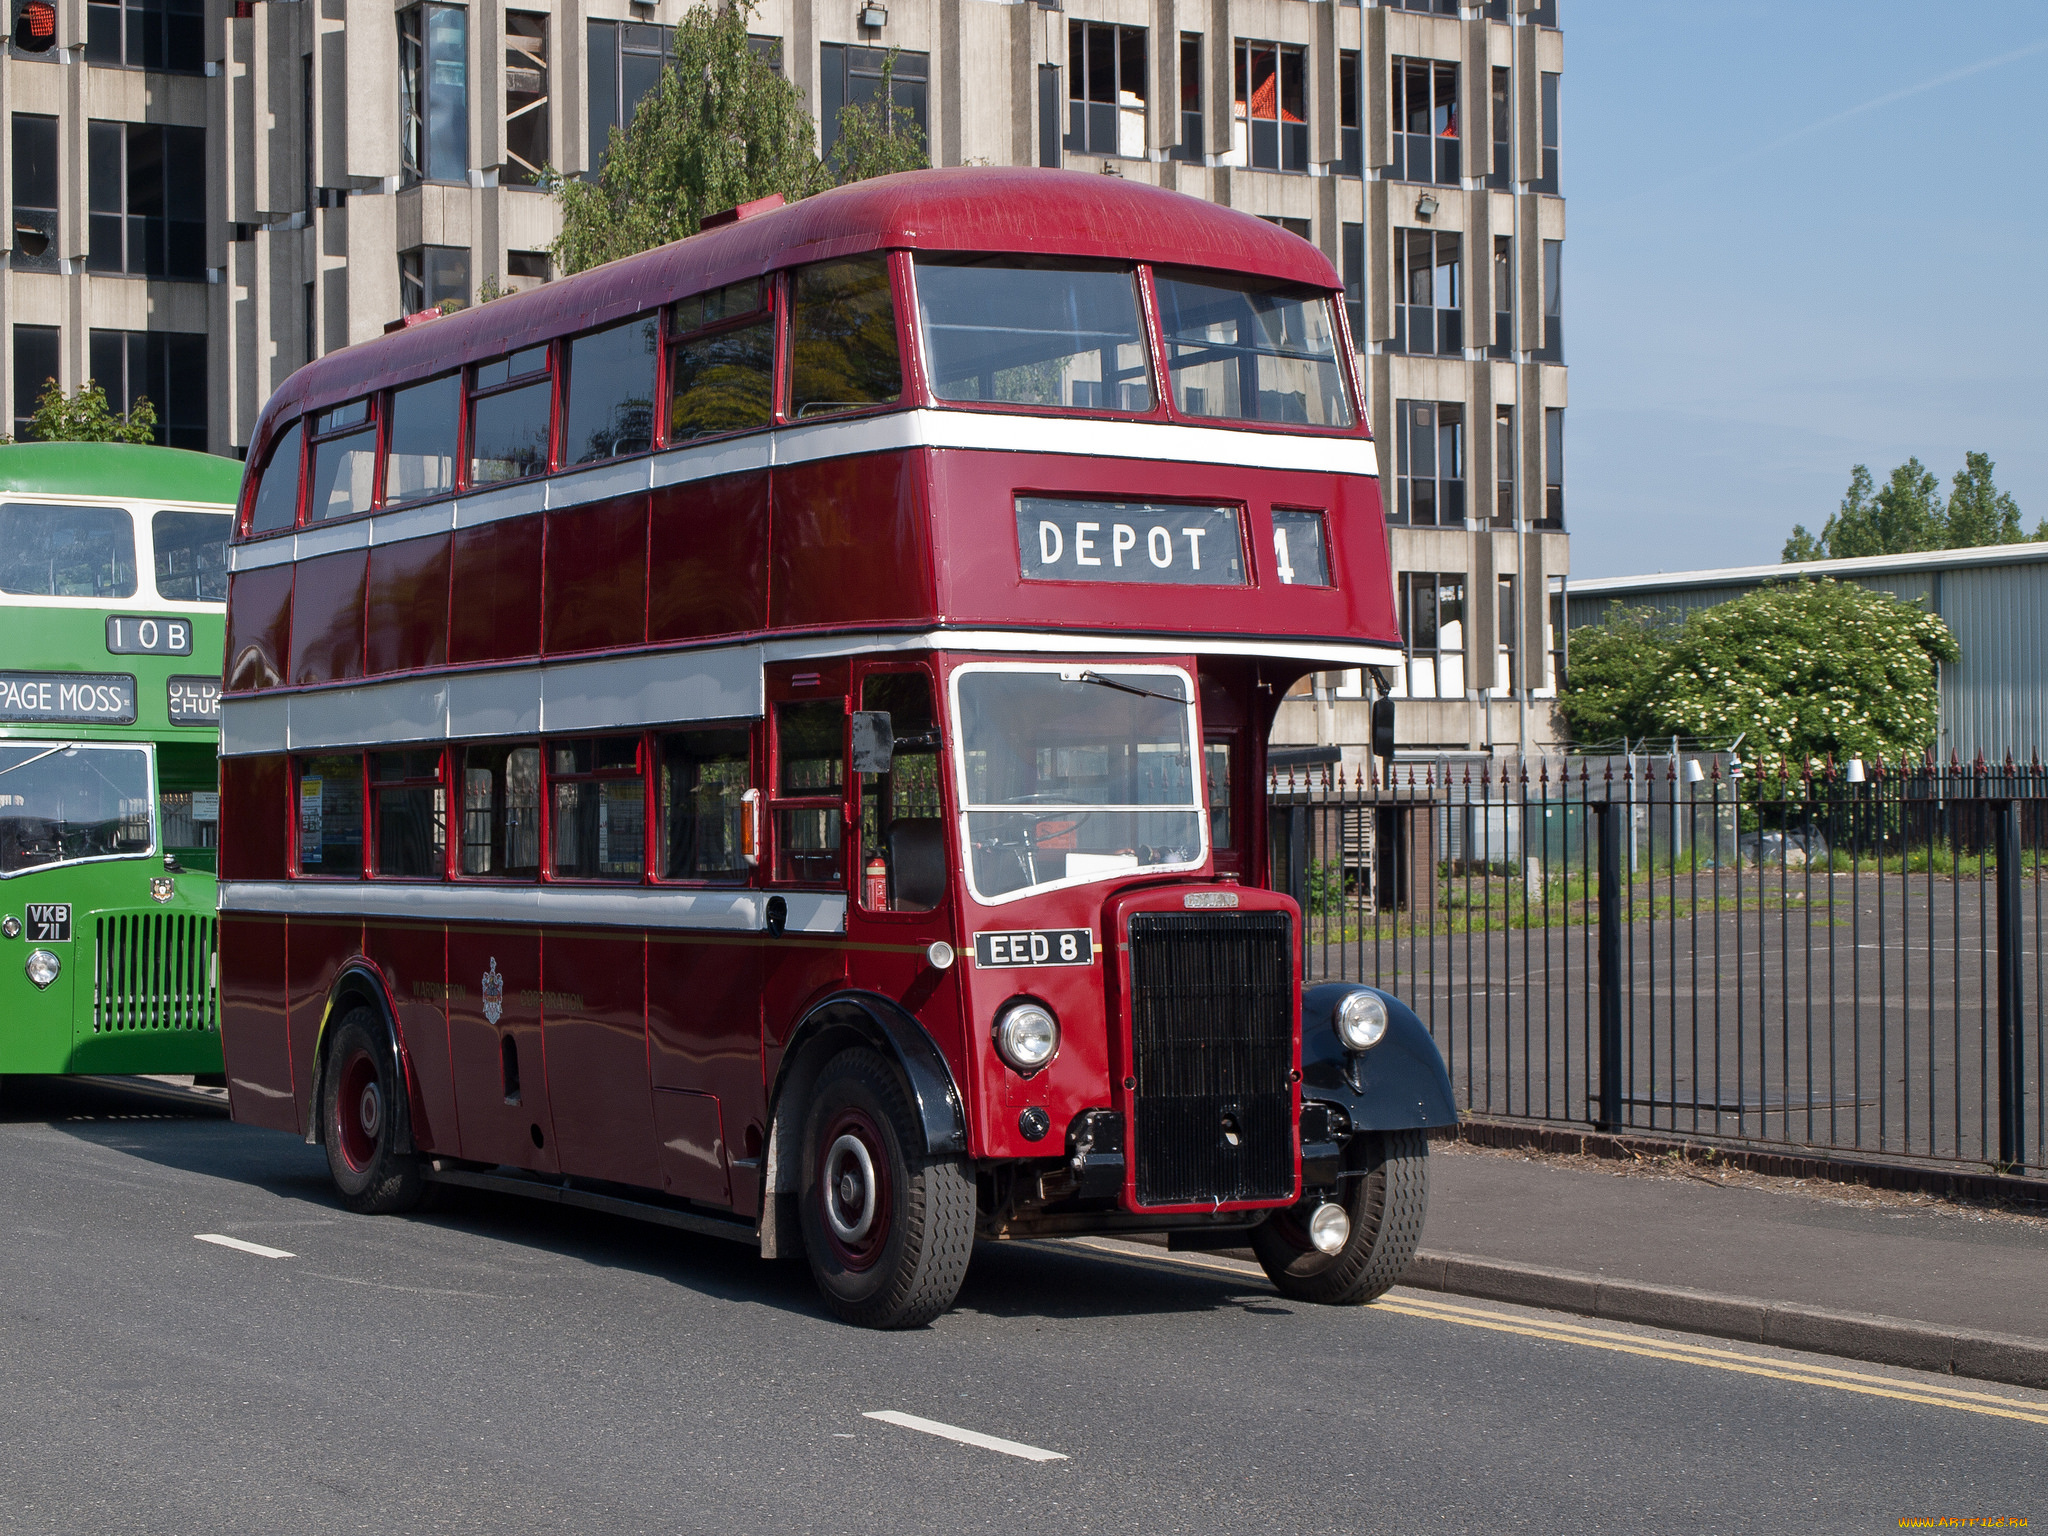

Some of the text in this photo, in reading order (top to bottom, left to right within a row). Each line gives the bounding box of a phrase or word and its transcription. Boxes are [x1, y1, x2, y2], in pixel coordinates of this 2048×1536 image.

[1039, 520, 1206, 570] DEPOT
[0, 681, 122, 712] PAGE MOSS
[169, 683, 216, 698] OLD
[170, 698, 220, 714] CHUR
[30, 905, 68, 923] VKB
[38, 923, 60, 940] 711
[989, 933, 1078, 963] EED 8
[520, 989, 584, 1011] CORPORATION
